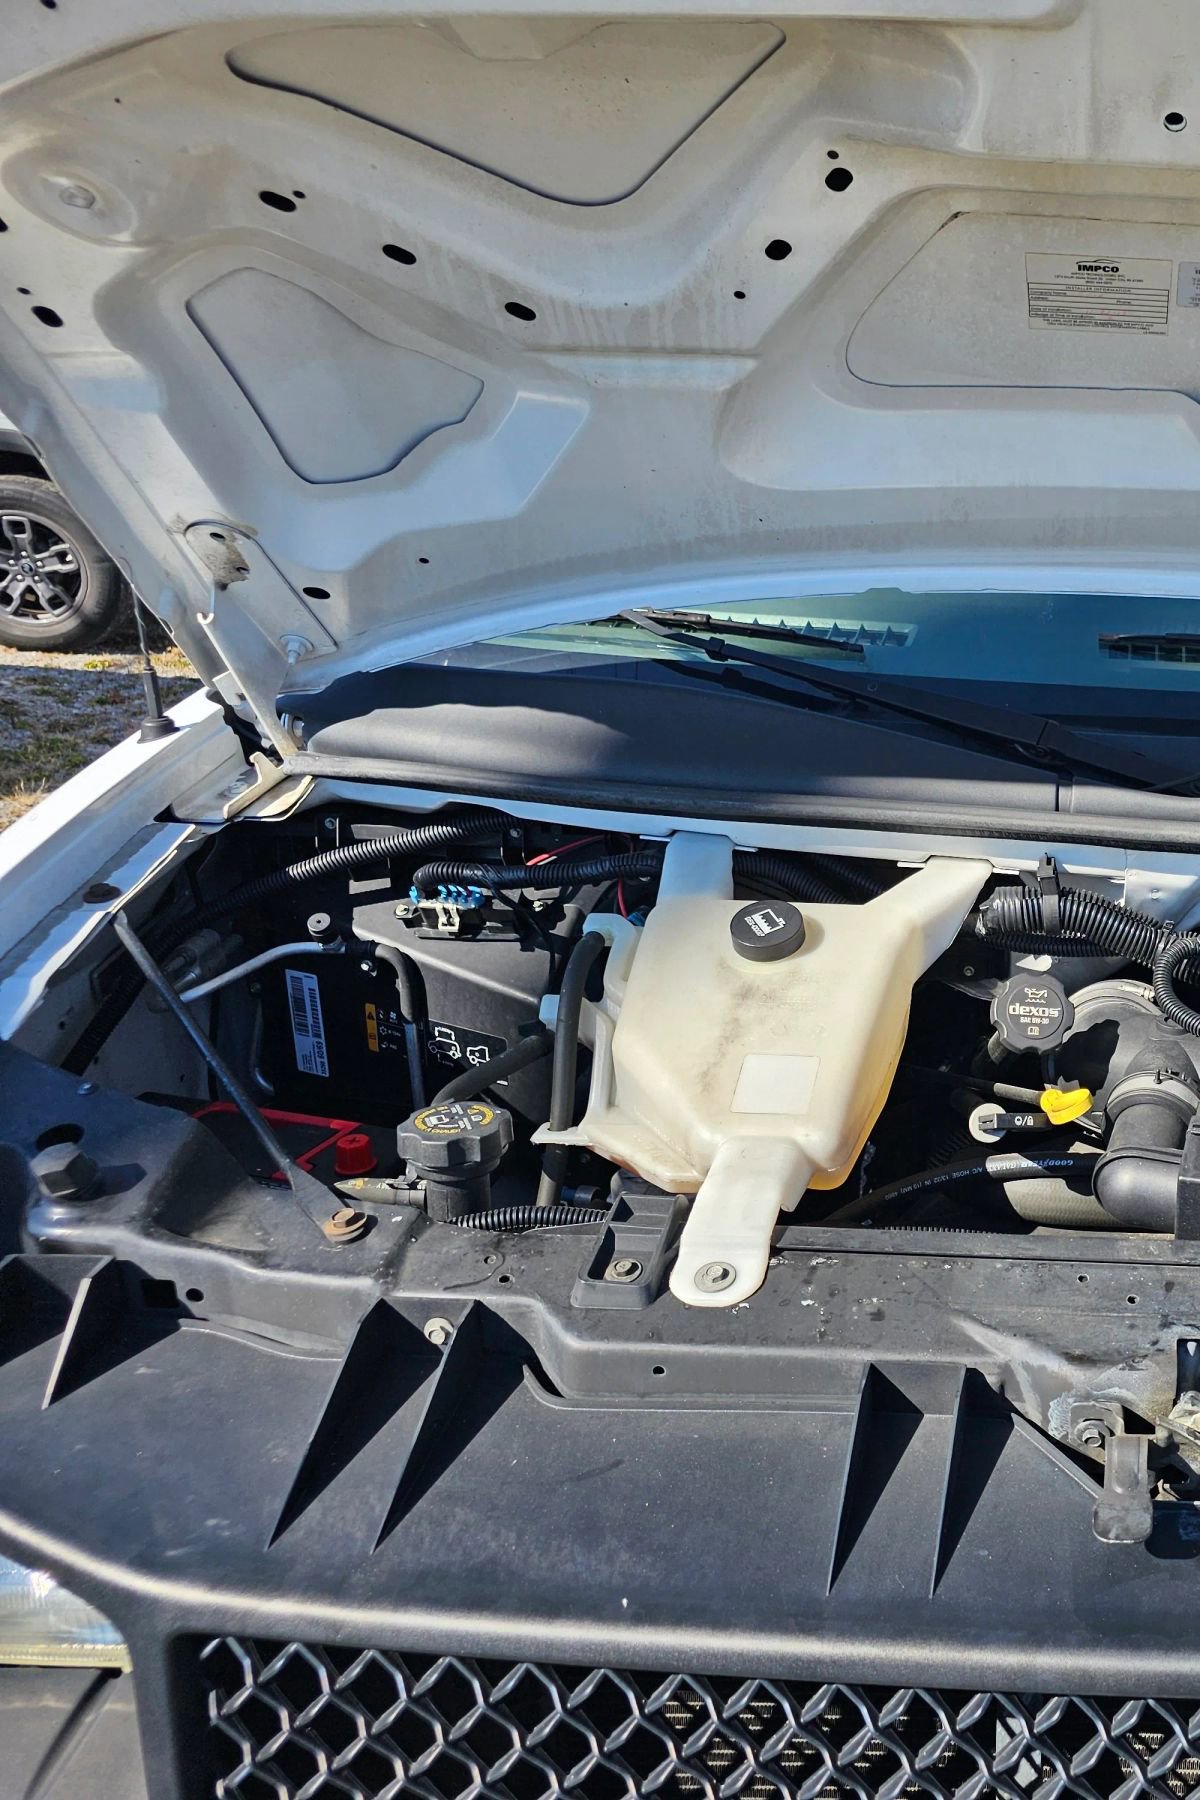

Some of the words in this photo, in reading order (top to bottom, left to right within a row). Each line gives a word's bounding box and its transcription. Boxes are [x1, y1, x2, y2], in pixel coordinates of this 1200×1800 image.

[1077, 264, 1120, 273] IMPCO
[1009, 1002, 1061, 1018] dexos
[1020, 1159, 1075, 1168] GOODYEAR
[952, 1170, 970, 1179] HOSE
